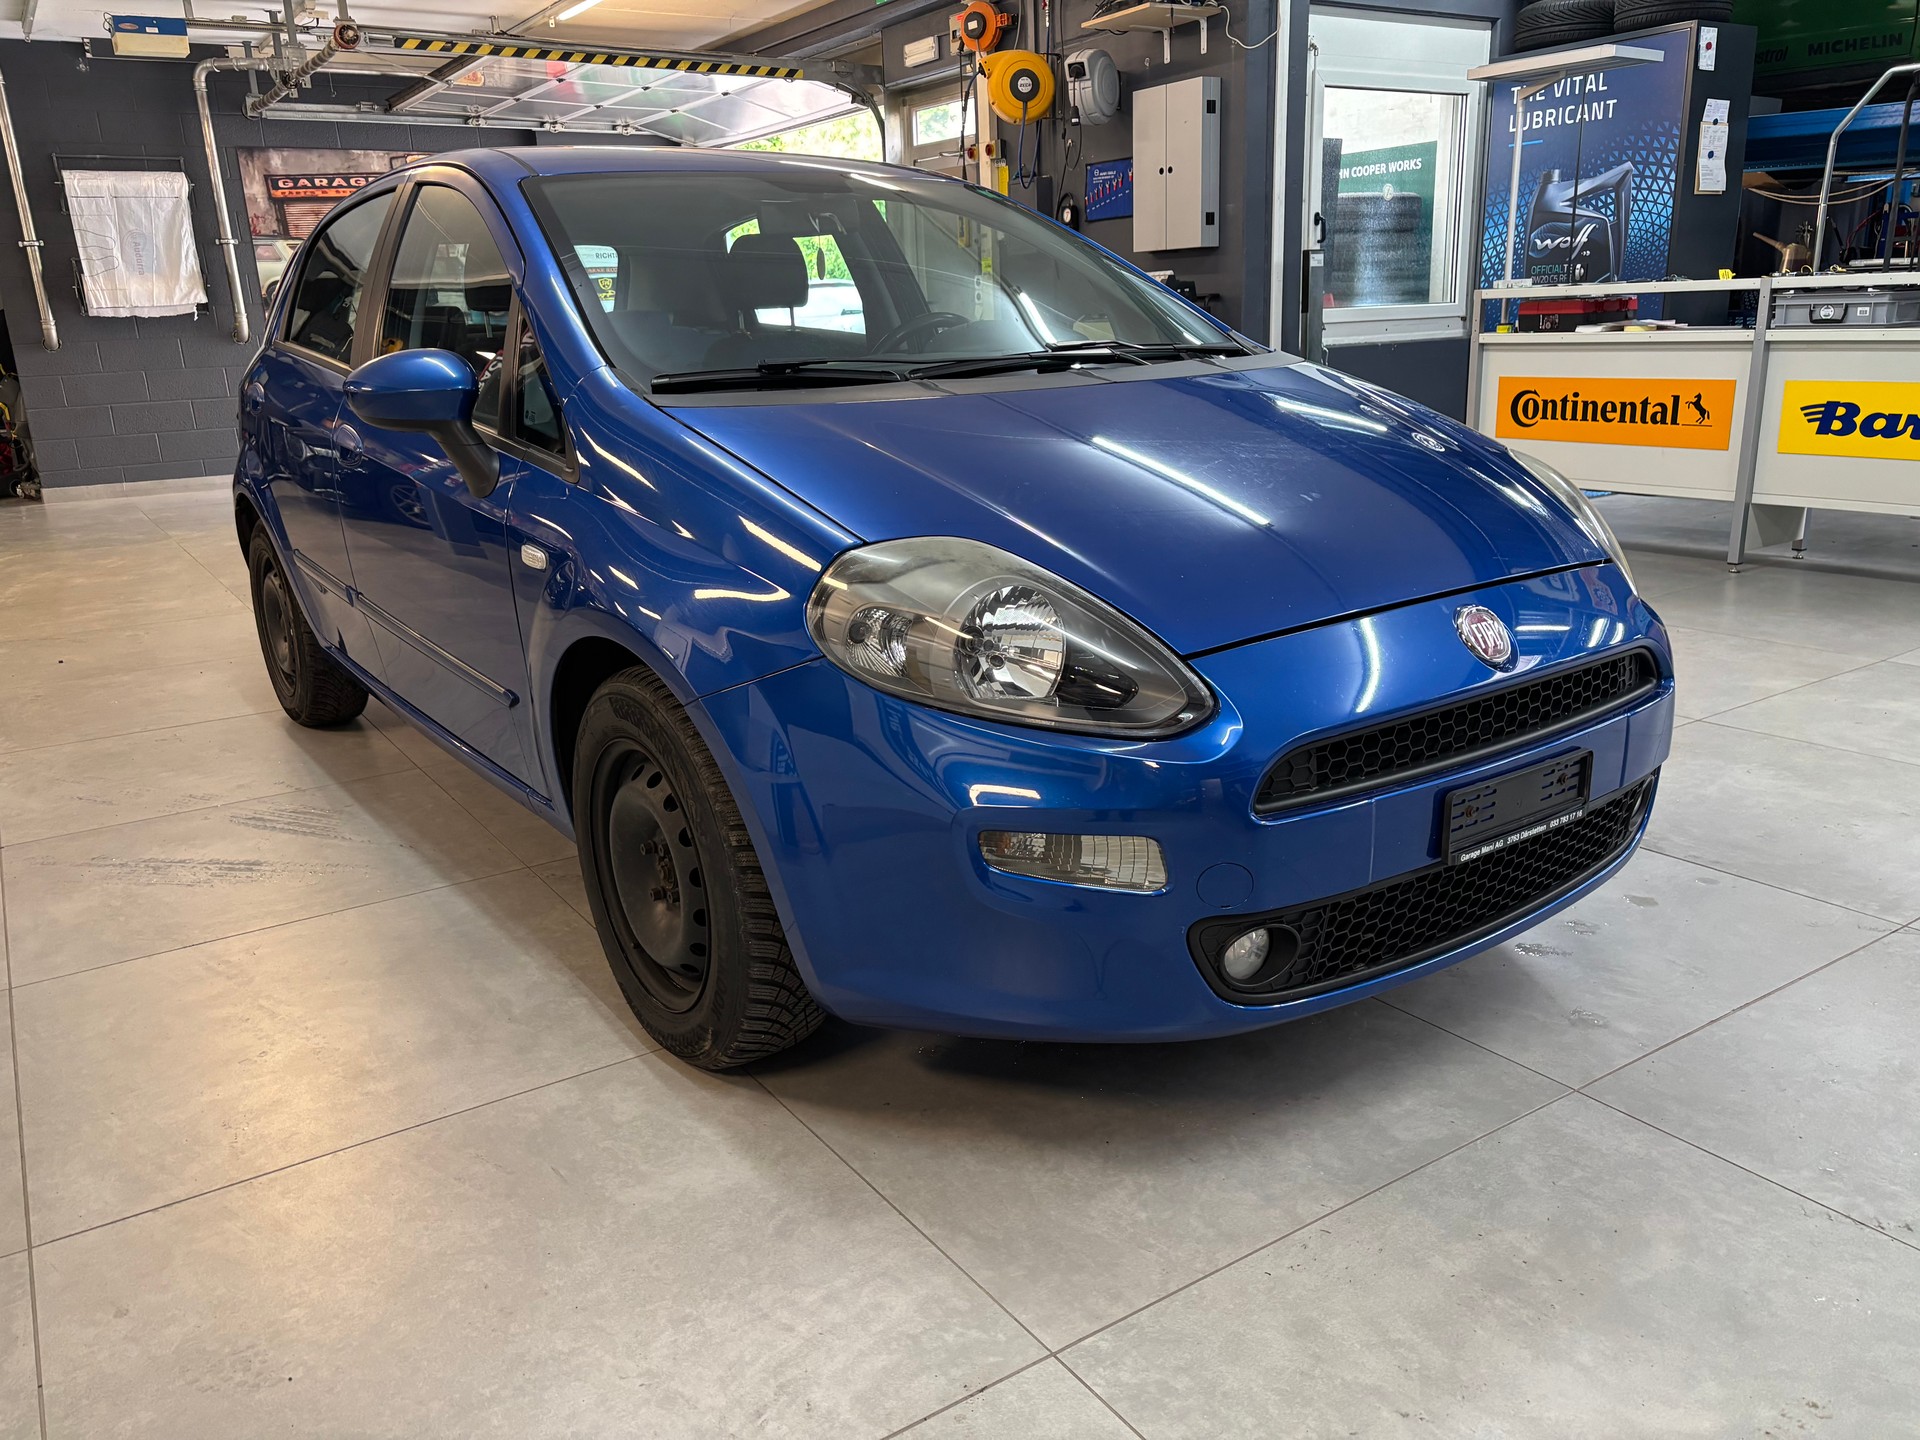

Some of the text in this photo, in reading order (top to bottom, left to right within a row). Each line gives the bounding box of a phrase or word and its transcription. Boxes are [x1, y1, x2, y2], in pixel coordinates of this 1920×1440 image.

[1754, 33, 1903, 65] strol MICHELIN
[1511, 72, 1608, 104] TE VITAL
[1508, 99, 1618, 133] LUBRICANT
[1351, 163, 1387, 178] COOPER
[1388, 157, 1422, 173] WORKS
[1510, 388, 1681, 428] Continental
[1470, 615, 1504, 651] FIAT
[1460, 849, 1480, 861] Garage
[1495, 840, 1504, 849] AG
